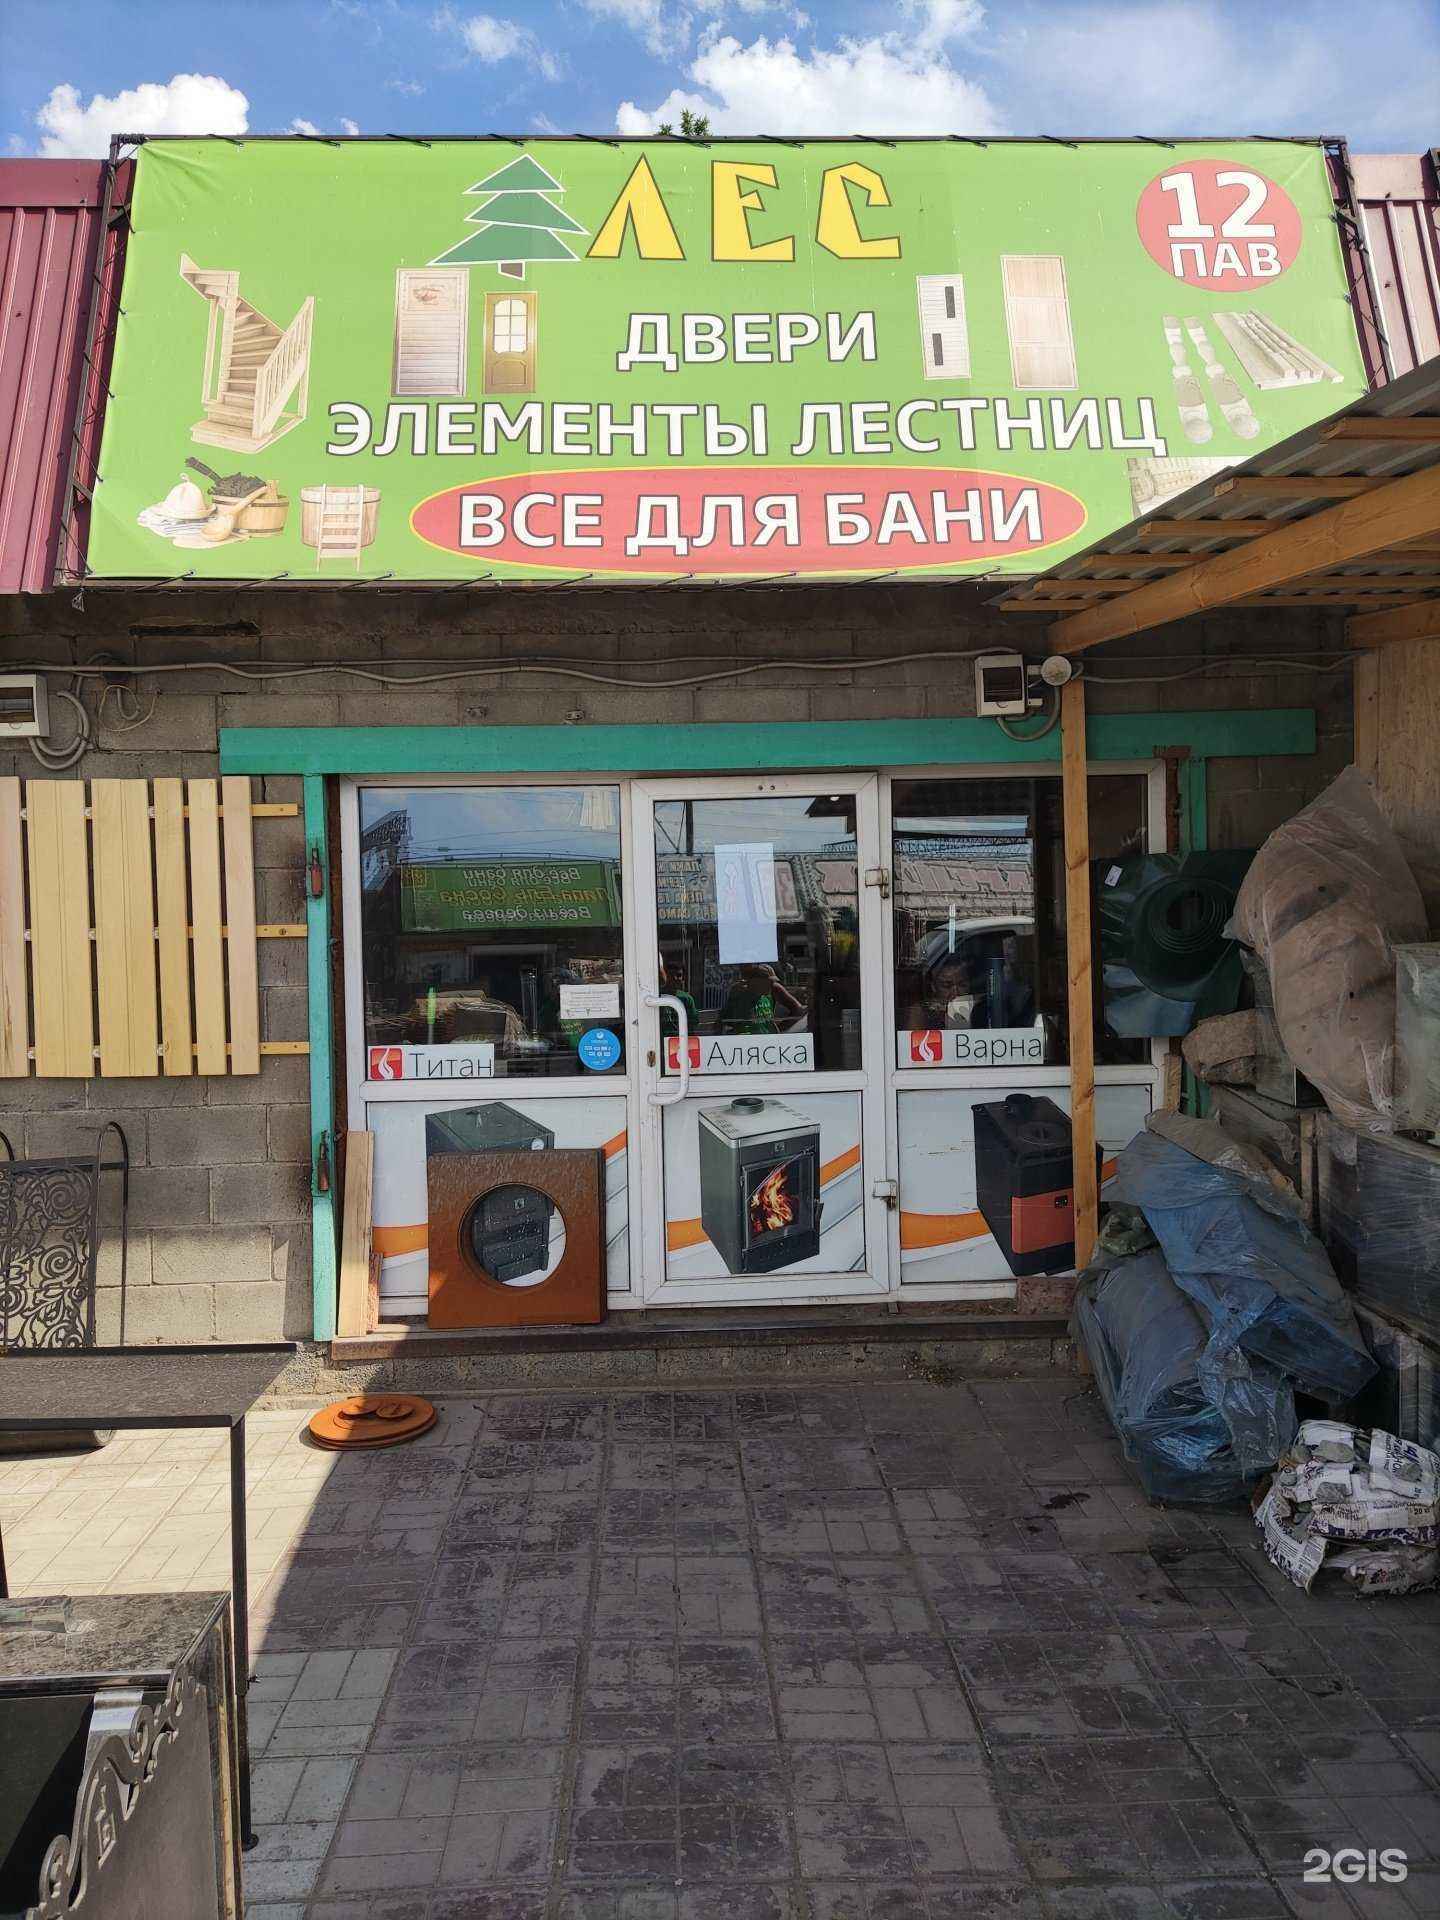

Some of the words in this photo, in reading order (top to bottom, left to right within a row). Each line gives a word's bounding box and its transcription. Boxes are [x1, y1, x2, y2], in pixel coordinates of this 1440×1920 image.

[585, 153, 901, 262] ЛЕС
[1160, 169, 1277, 239] 12
[1168, 241, 1282, 278] ПАВ
[616, 311, 877, 372] ДВЕРИ
[326, 400, 768, 456] ЭЛЕМЕНТЫ
[791, 397, 1167, 457] ЛЕСТНИЦ
[459, 493, 603, 548] ВСЕ
[625, 493, 801, 557] ДЛЯ
[825, 488, 1044, 546] БАНИ
[408, 1052, 493, 1078] Титан
[706, 1040, 809, 1068] Аляска
[955, 1034, 1041, 1064] Варна
